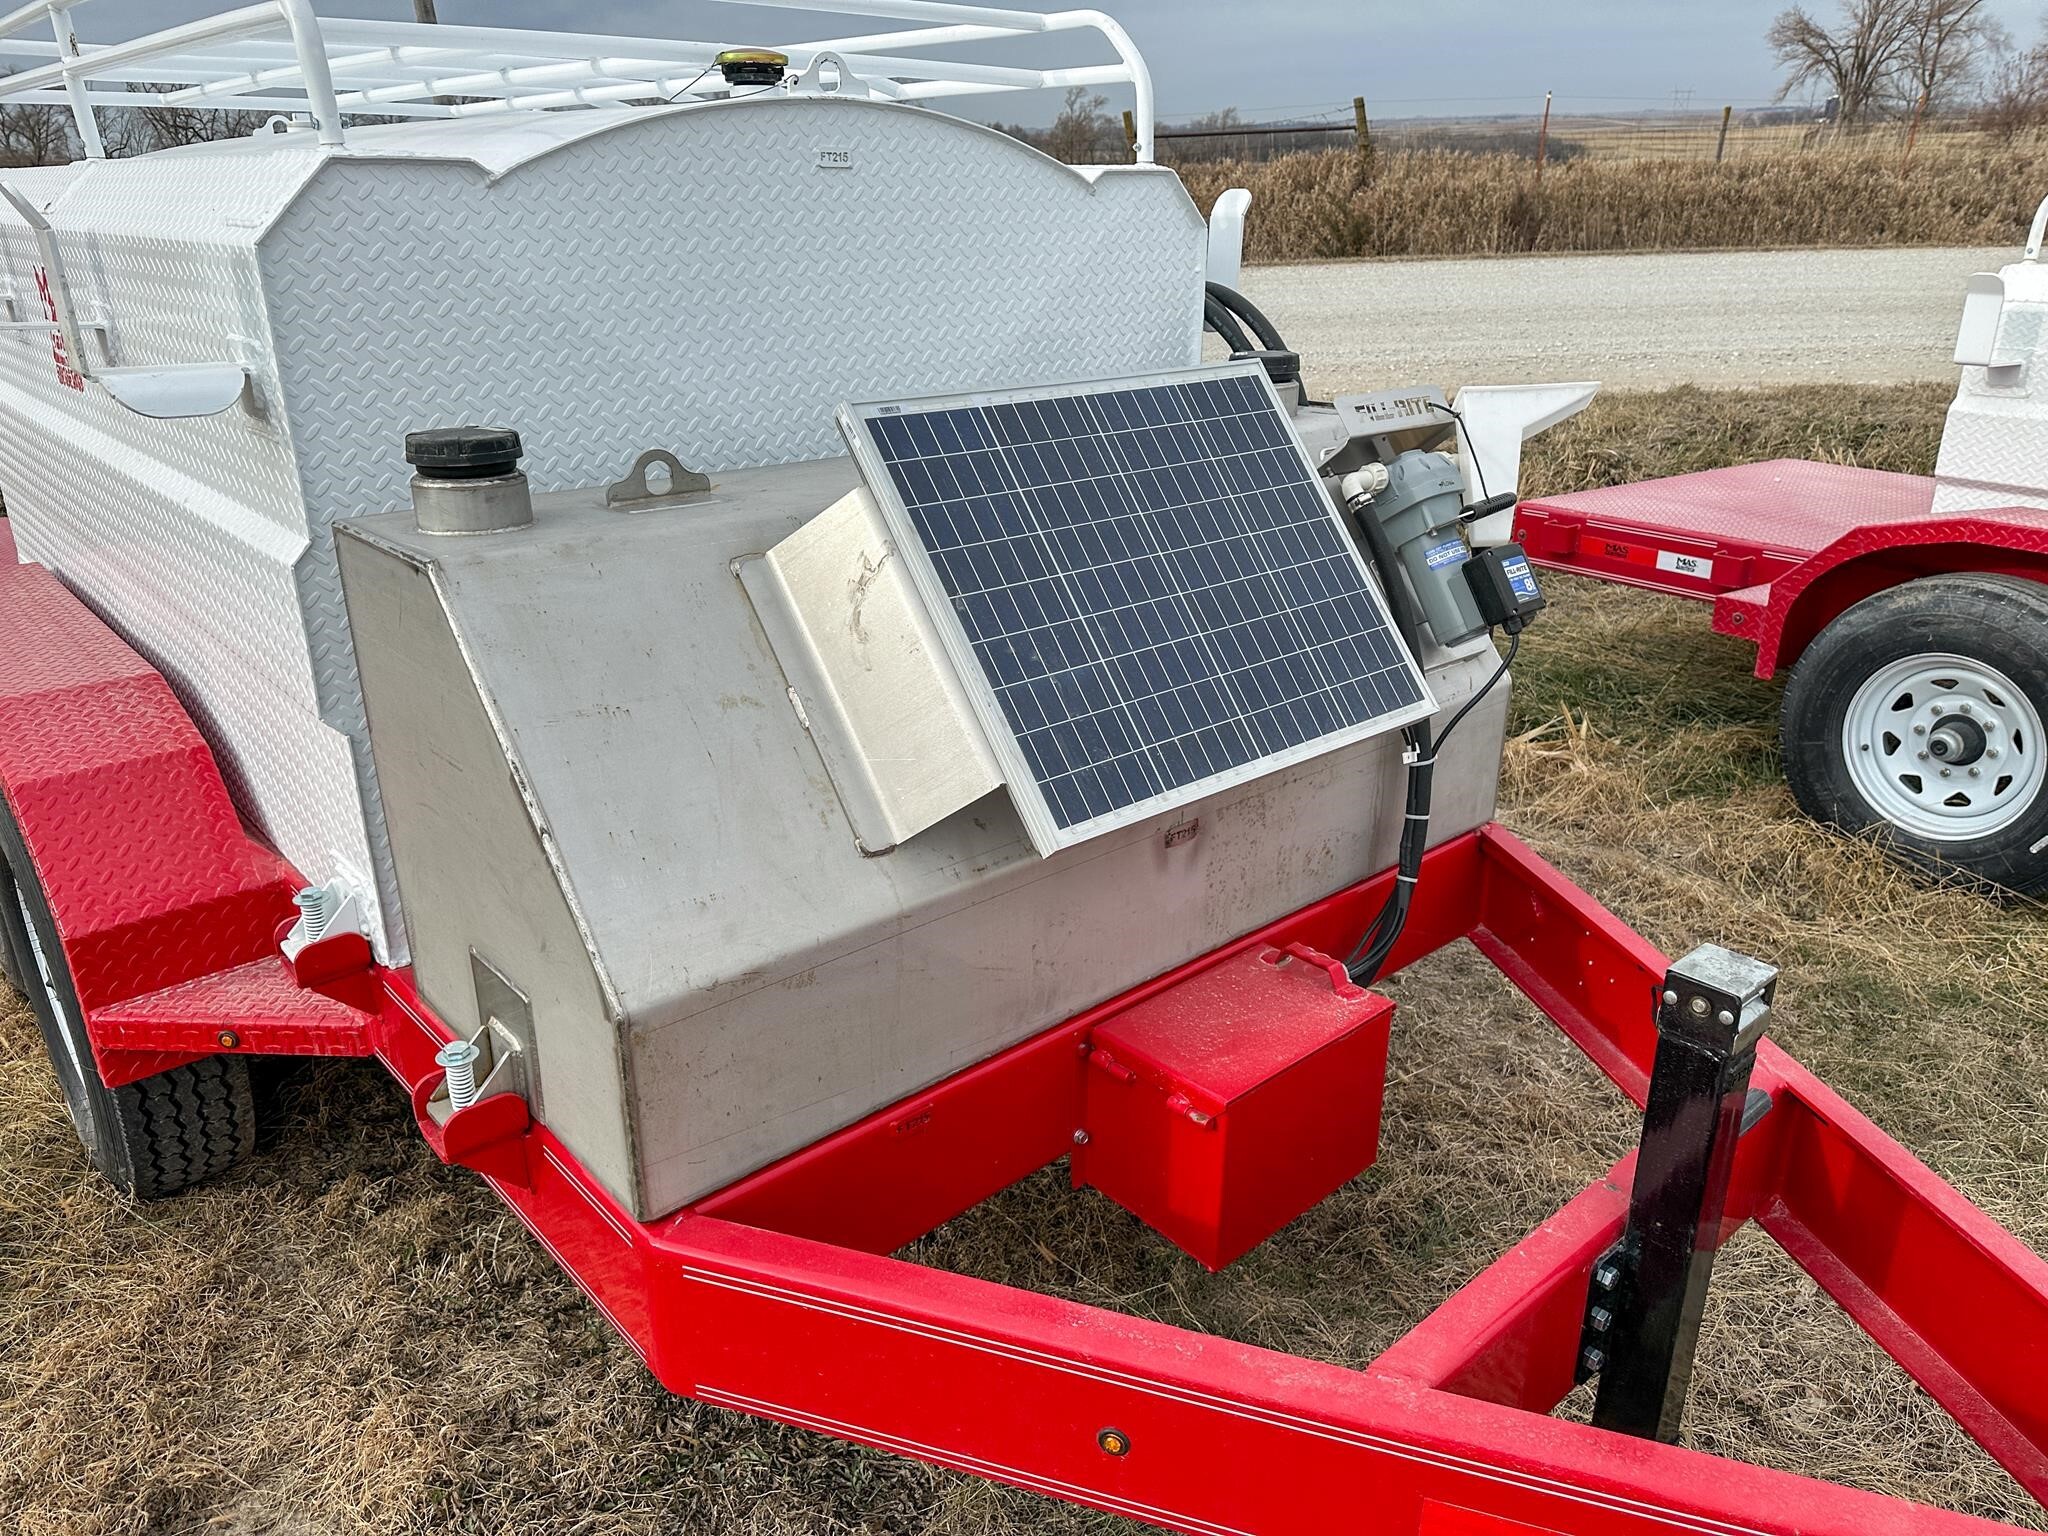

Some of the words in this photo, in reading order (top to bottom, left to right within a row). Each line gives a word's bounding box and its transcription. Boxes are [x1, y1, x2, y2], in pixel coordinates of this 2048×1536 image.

[820, 151, 849, 163] FT215
[1605, 543, 1629, 554] MAS
[1428, 556, 1438, 564] DO
[1438, 551, 1451, 560] NOT
[1676, 556, 1697, 567] MAS
[1507, 564, 1528, 575] FILL-RITE
